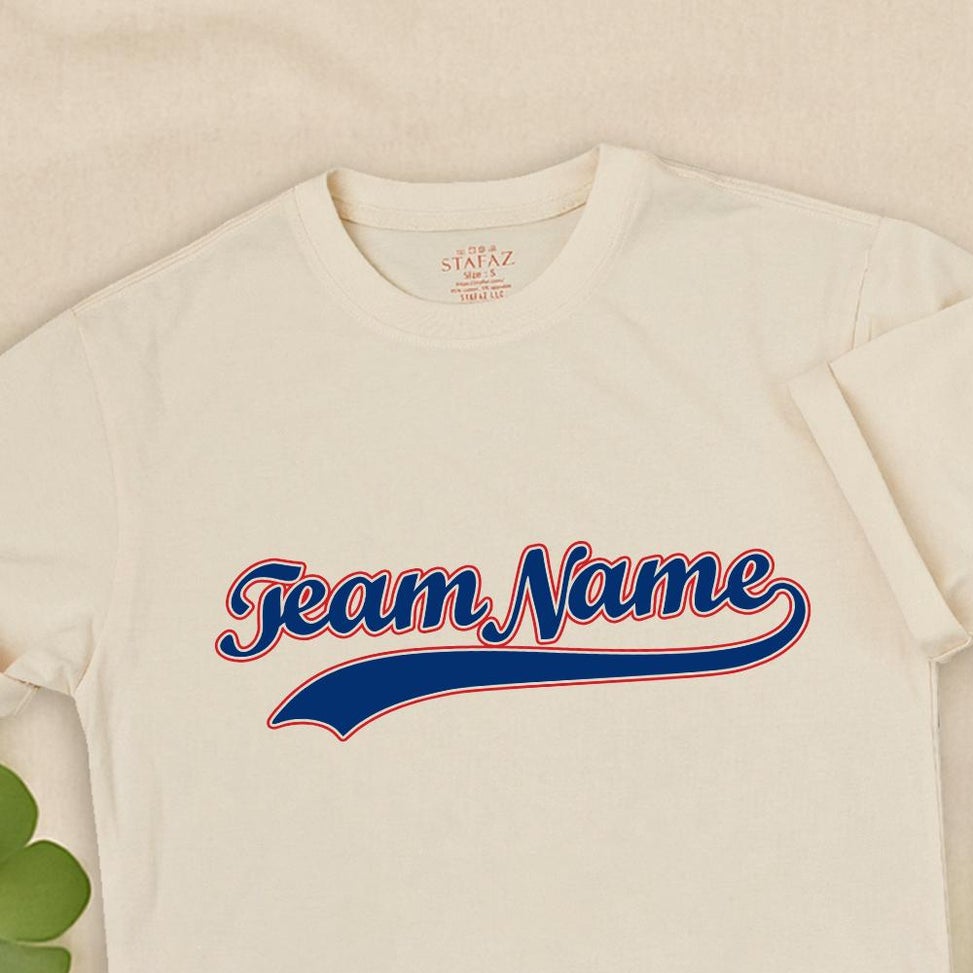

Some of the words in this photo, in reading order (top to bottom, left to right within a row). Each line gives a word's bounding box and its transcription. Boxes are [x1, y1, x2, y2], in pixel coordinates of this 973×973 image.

[441, 250, 516, 272] STAFAZ
[215, 557, 493, 662] Team
[477, 541, 782, 645] Name
